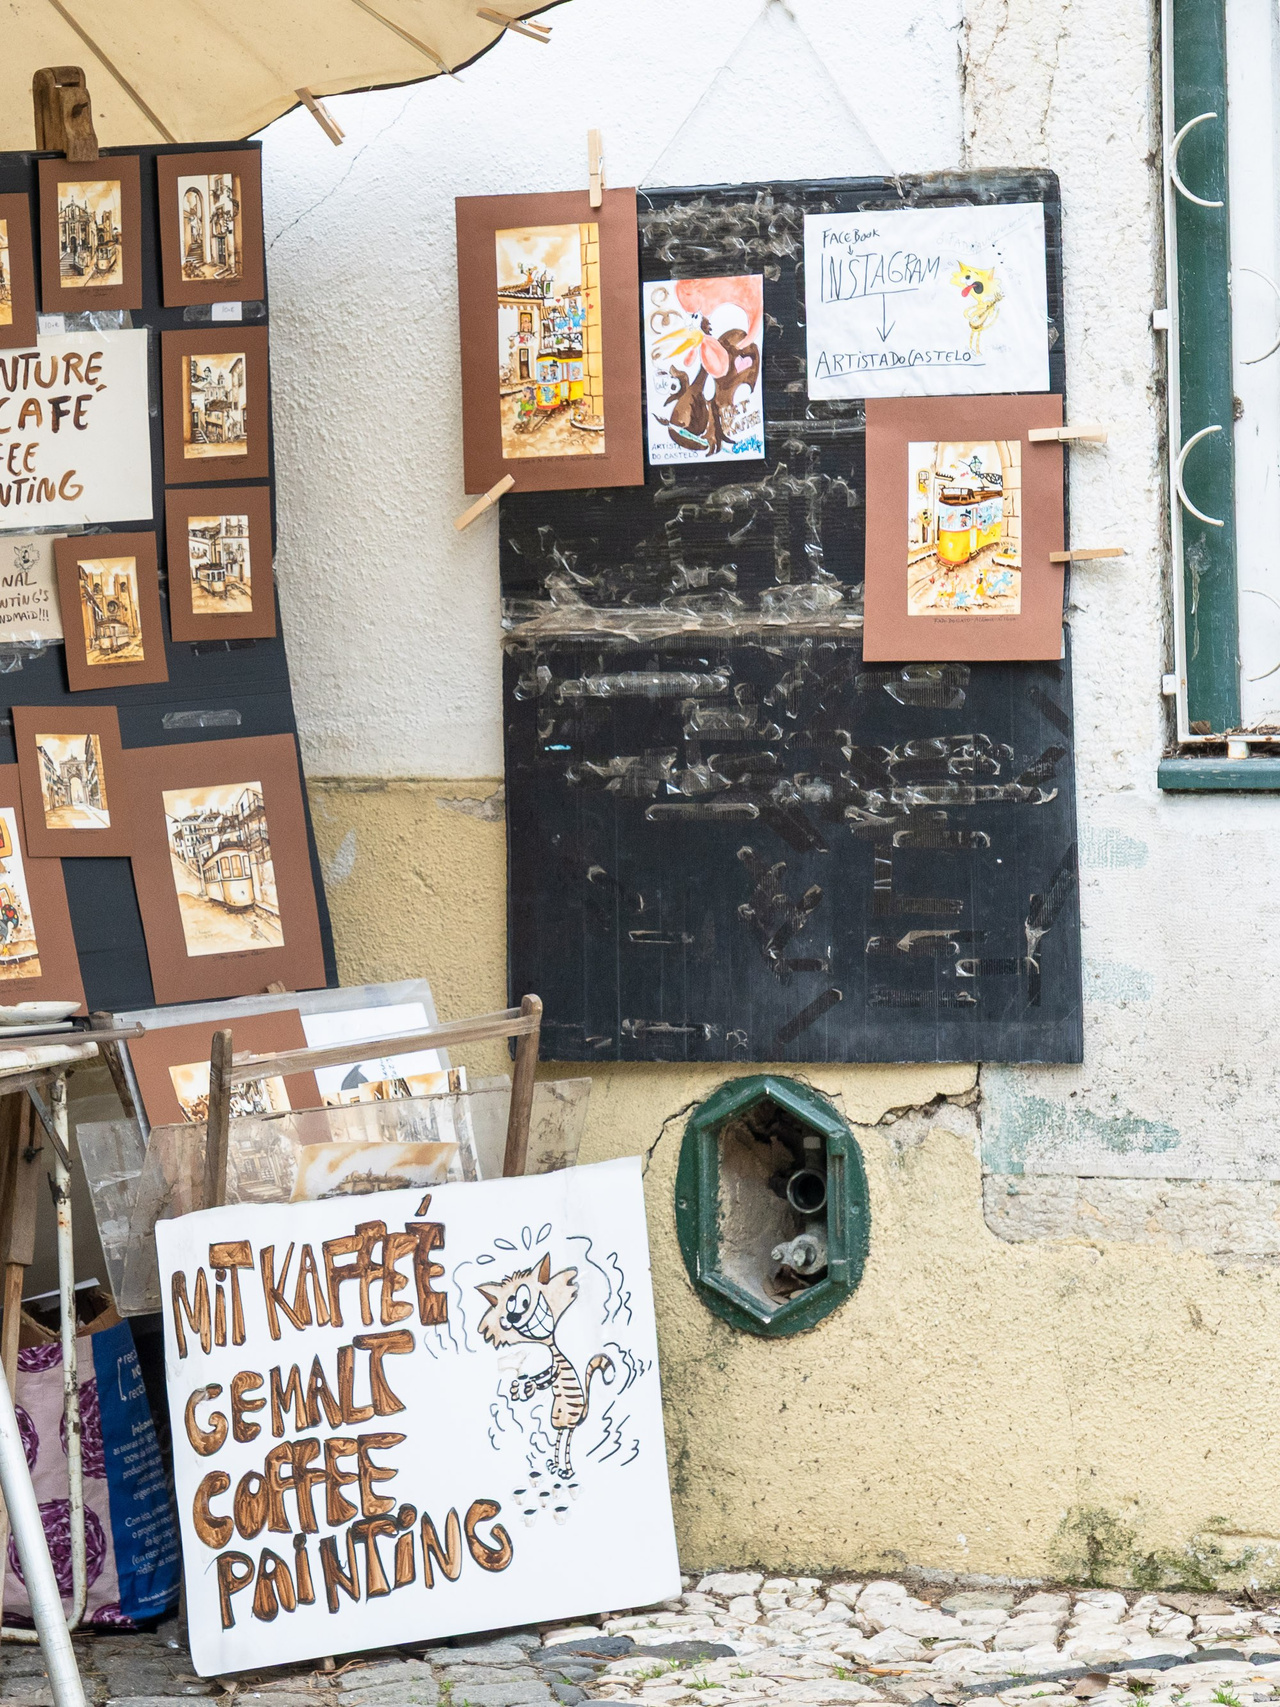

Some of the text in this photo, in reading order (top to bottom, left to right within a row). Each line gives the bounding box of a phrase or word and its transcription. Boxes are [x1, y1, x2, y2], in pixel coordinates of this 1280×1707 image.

[821, 251, 941, 303] INSTAGRAM
[171, 1239, 255, 1360] MIT
[183, 1328, 415, 1457] GEMALT
[192, 1431, 407, 1550] COFFEE
[215, 1498, 515, 1631] PAINTING
